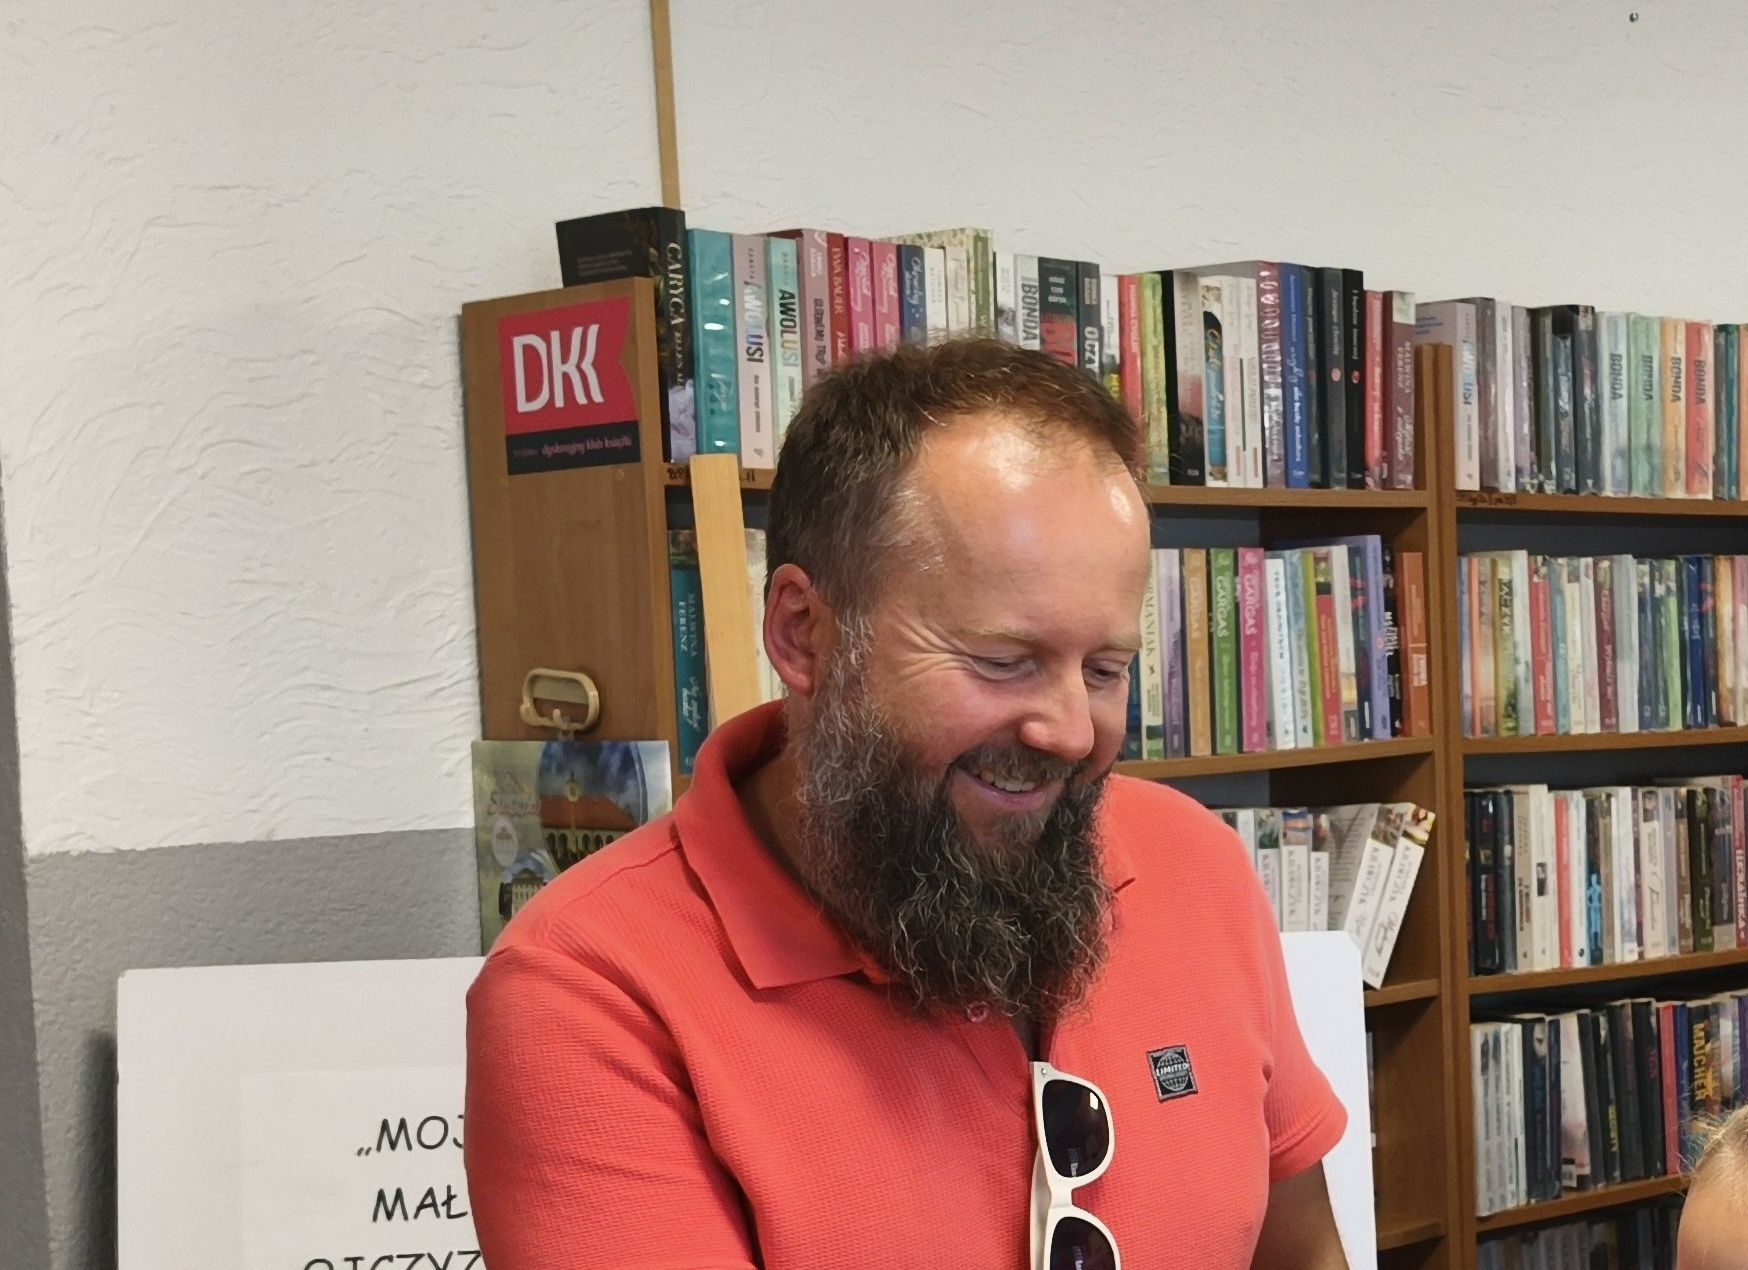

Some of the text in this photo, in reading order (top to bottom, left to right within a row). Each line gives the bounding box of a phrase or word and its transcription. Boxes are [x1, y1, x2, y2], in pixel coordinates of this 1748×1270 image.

[666, 242, 685, 325] CARYCA
[1021, 283, 1040, 342] BONDA
[778, 289, 799, 368] AWOLUSI
[355, 1114, 465, 1157] „MO
[371, 1184, 469, 1223] MAŁ
